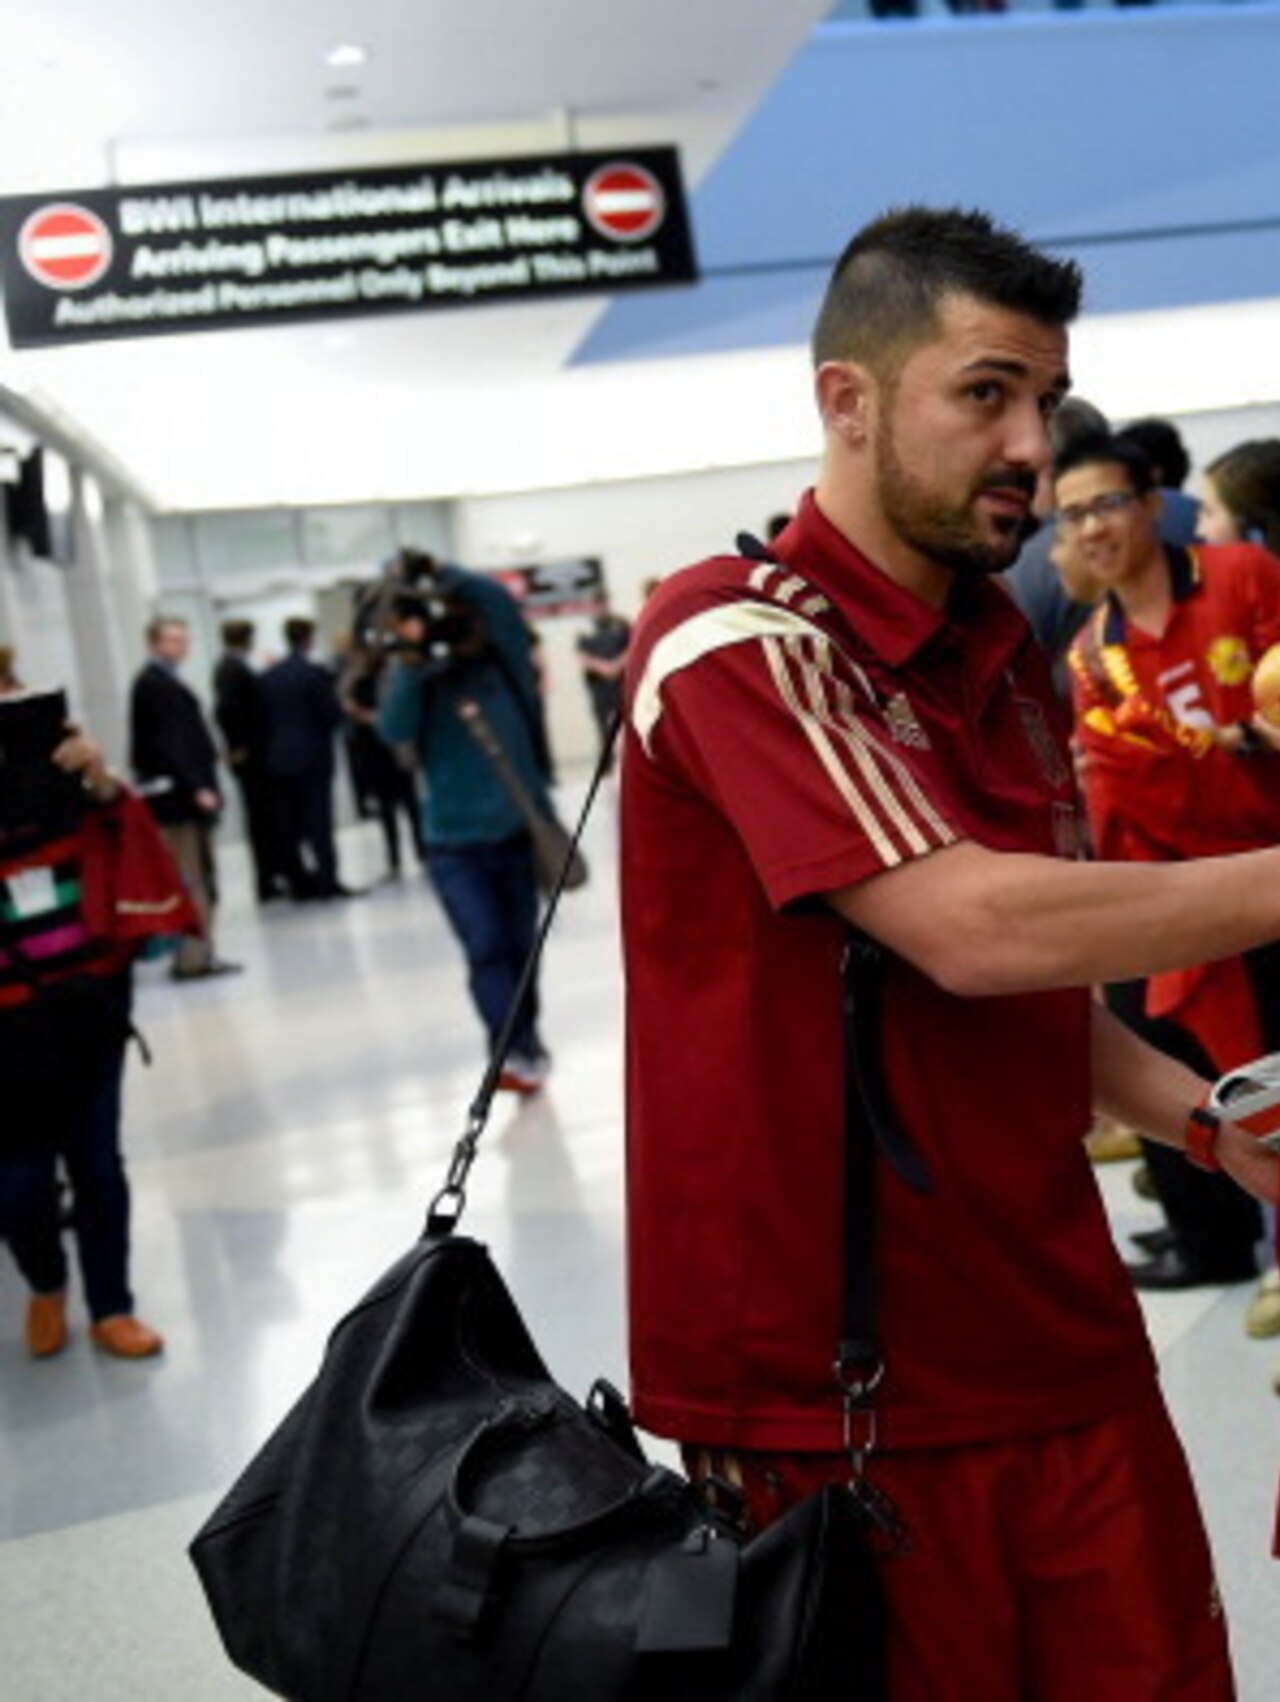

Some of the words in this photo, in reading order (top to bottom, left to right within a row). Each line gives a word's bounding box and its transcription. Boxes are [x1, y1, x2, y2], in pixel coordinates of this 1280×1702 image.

[120, 195, 195, 234] BWI
[201, 175, 435, 227] International
[443, 167, 574, 209] Arrivals
[133, 240, 263, 278] Arriving
[265, 227, 440, 268] Passengers
[443, 215, 503, 250] Exit
[504, 215, 579, 246] Here
[57, 281, 216, 324] Authorized
[218, 270, 357, 311] Personnel
[359, 264, 423, 299] Only
[425, 254, 530, 295] Beyond
[532, 252, 587, 281] This
[587, 247, 657, 276] Point
